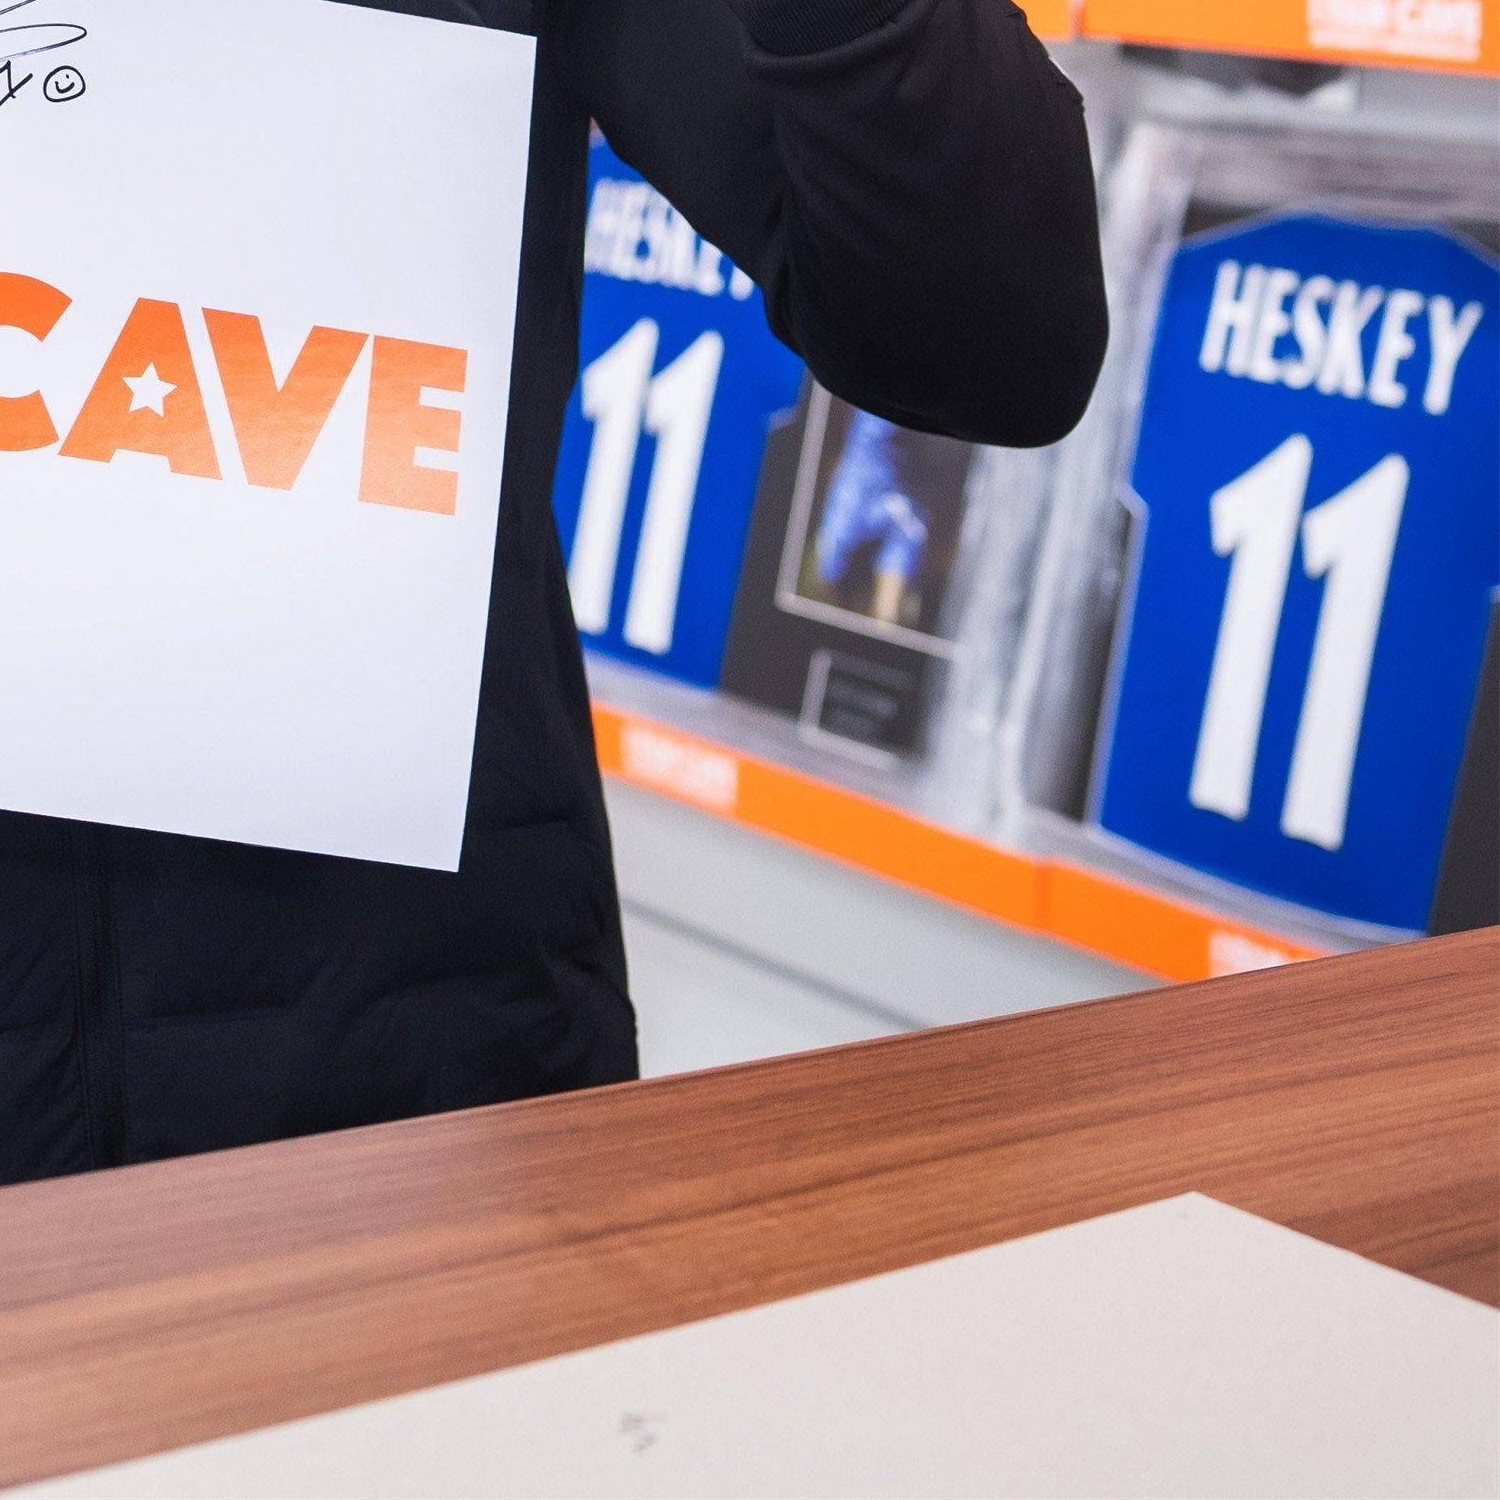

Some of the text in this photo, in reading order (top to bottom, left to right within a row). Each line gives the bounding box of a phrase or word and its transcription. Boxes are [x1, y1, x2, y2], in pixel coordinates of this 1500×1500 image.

[567, 318, 724, 656] 11
[1199, 258, 1484, 416] HESKEY
[1188, 433, 1411, 852] 11
